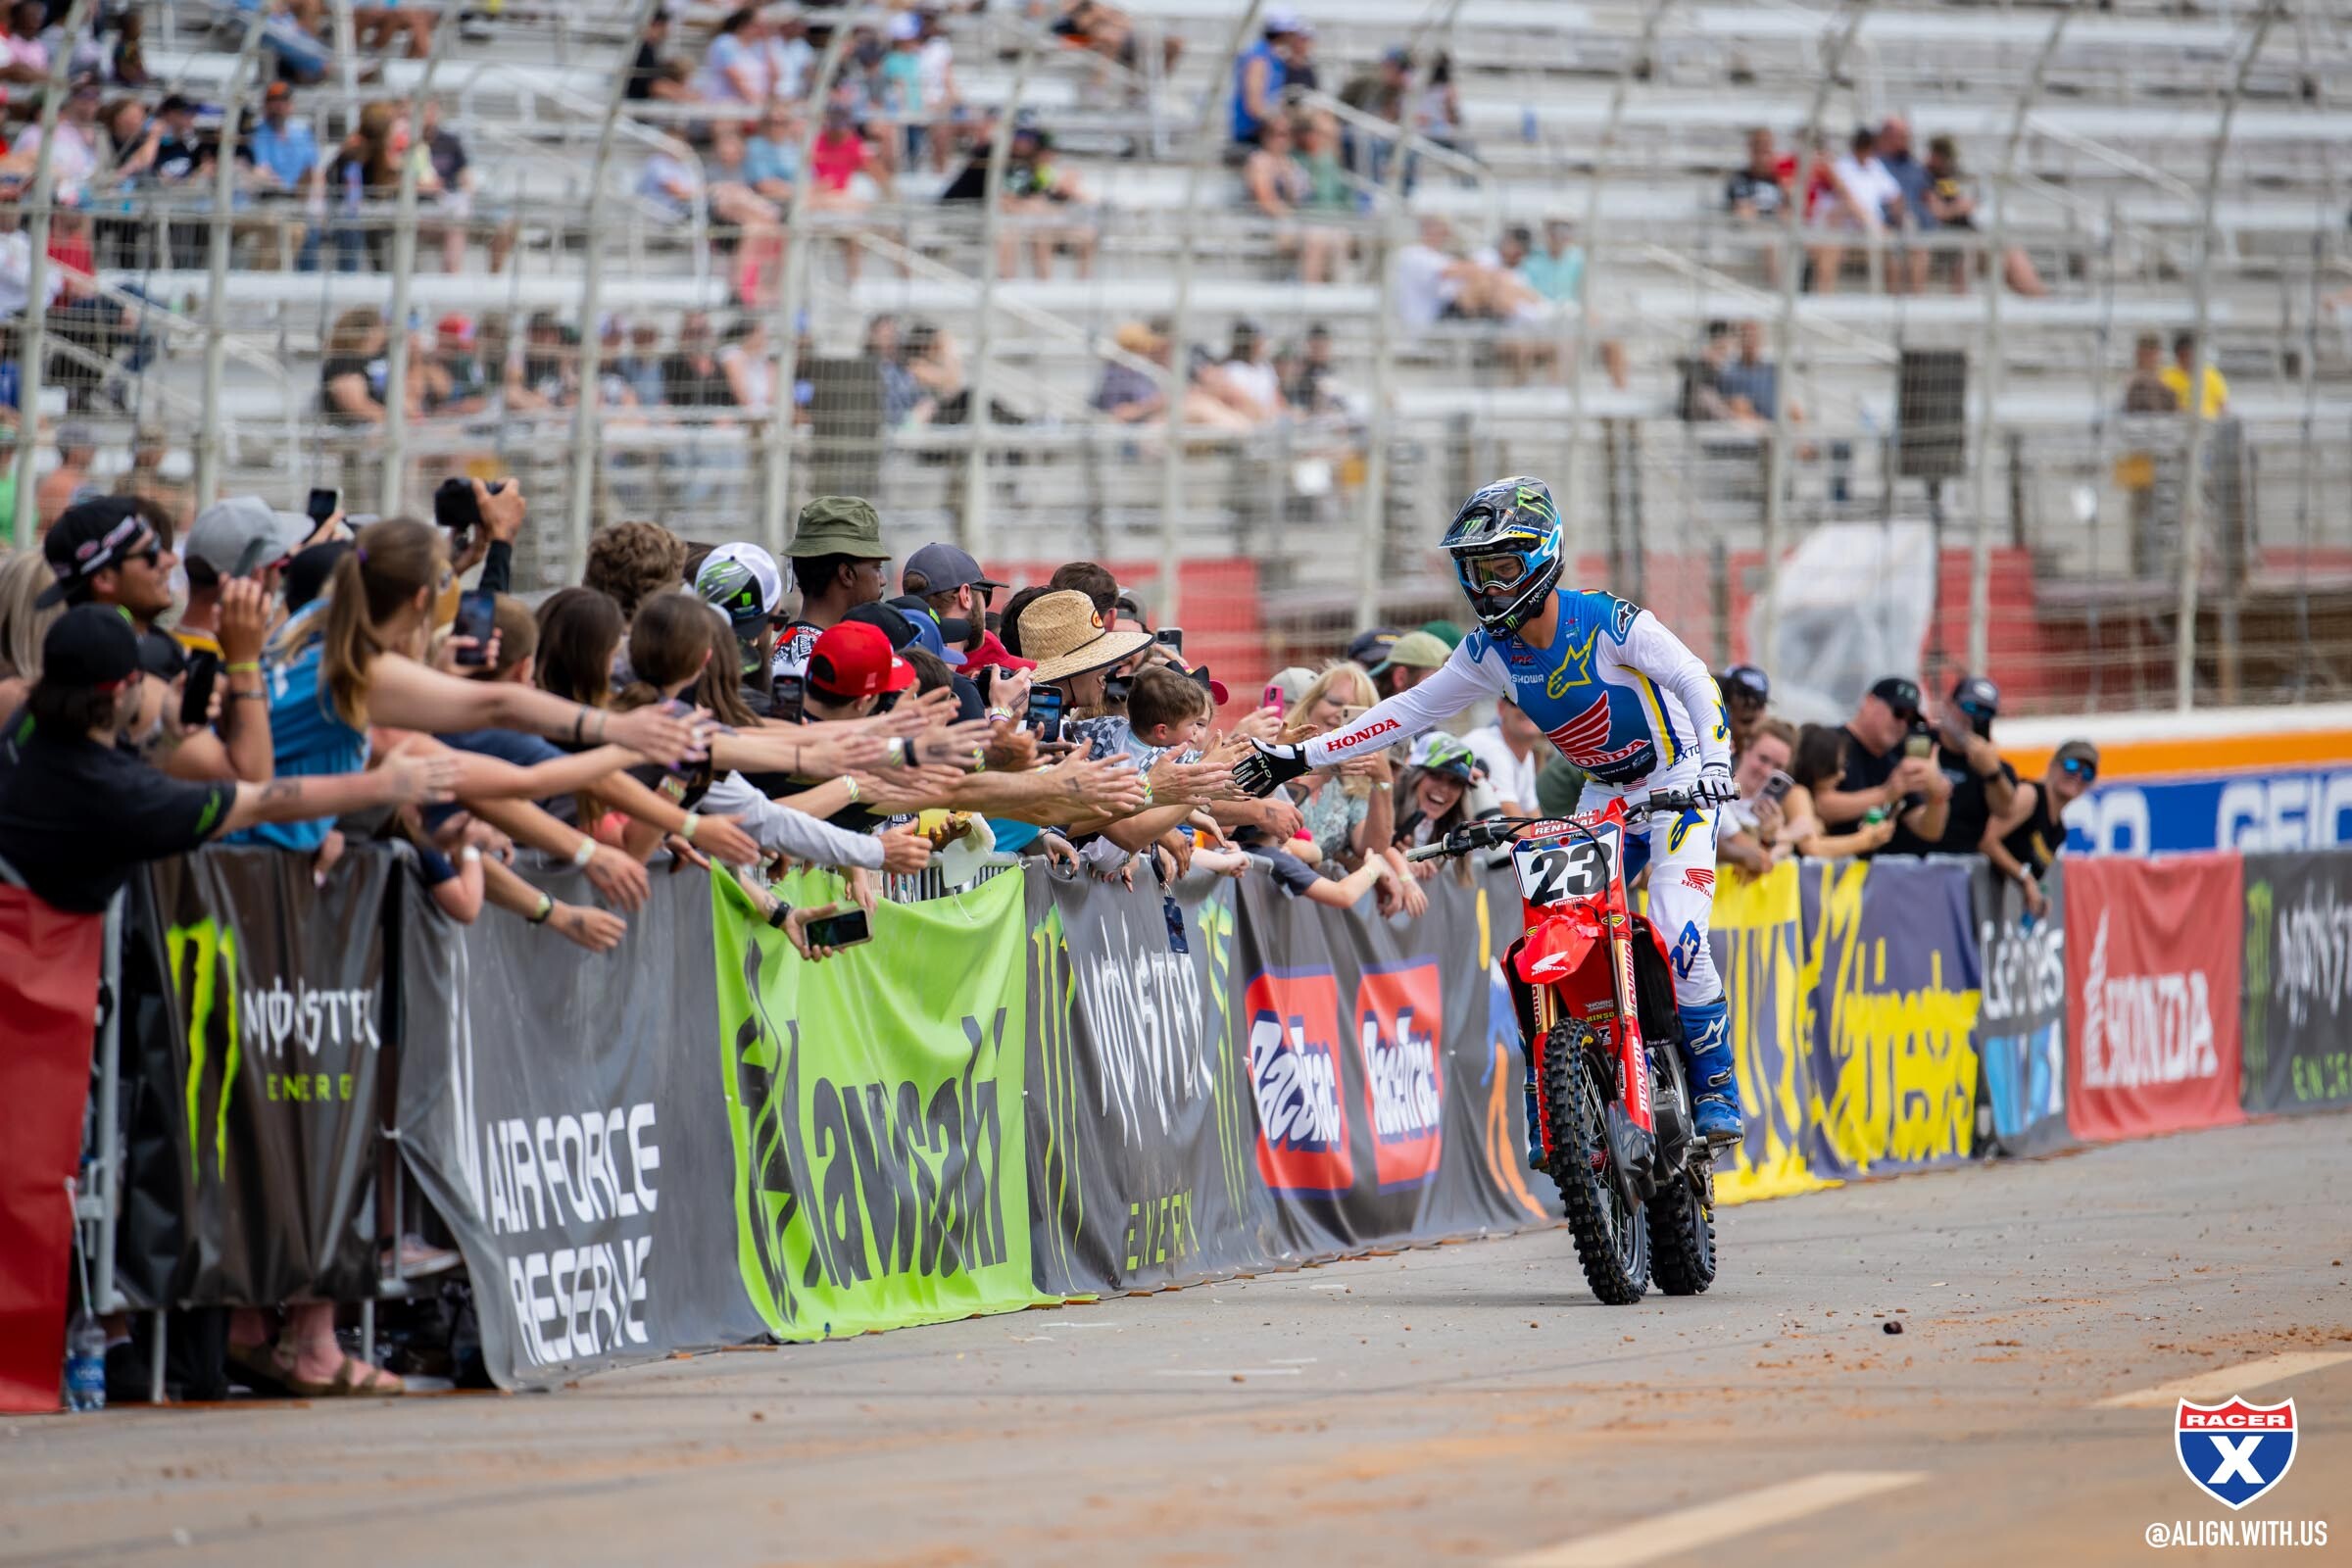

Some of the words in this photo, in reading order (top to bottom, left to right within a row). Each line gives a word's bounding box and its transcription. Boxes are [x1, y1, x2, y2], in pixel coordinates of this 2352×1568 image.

[1511, 674, 1544, 684] SHOWA
[1326, 718, 1401, 753] HONDA
[1666, 744, 1700, 771] SEXTO
[1530, 842, 1613, 907] 23
[1555, 897, 1585, 906] HONDA
[1670, 920, 1701, 980] 23
[1531, 964, 1568, 976] HONDA
[1632, 1035, 1649, 1115] DUNLOP
[508, 1235, 650, 1367] RESERVE
